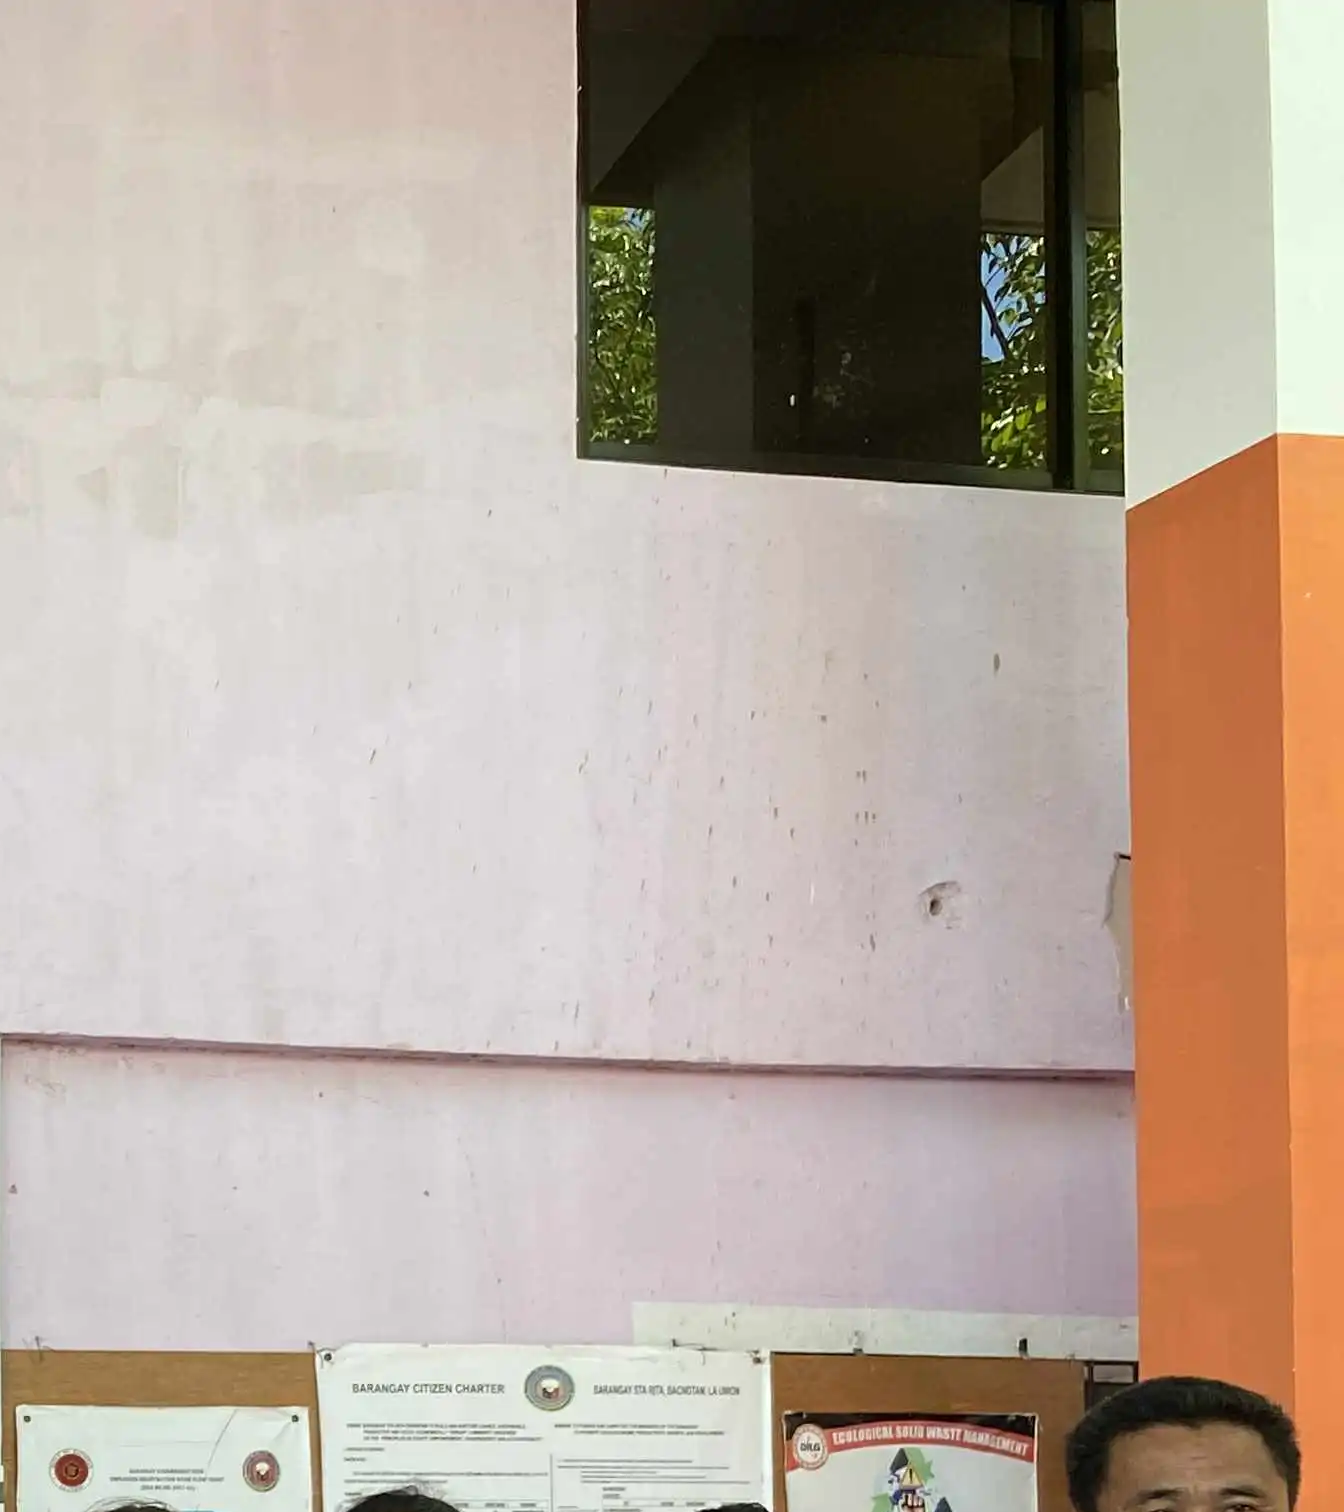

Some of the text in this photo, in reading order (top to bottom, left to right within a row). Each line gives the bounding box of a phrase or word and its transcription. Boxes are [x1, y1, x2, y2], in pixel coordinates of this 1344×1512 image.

[352, 1383, 505, 1395] BARANGAY CITIZEN CHARTER
[831, 1424, 1030, 1458] ECOLOGICAL SOLID WASTE MANAGEMENT
